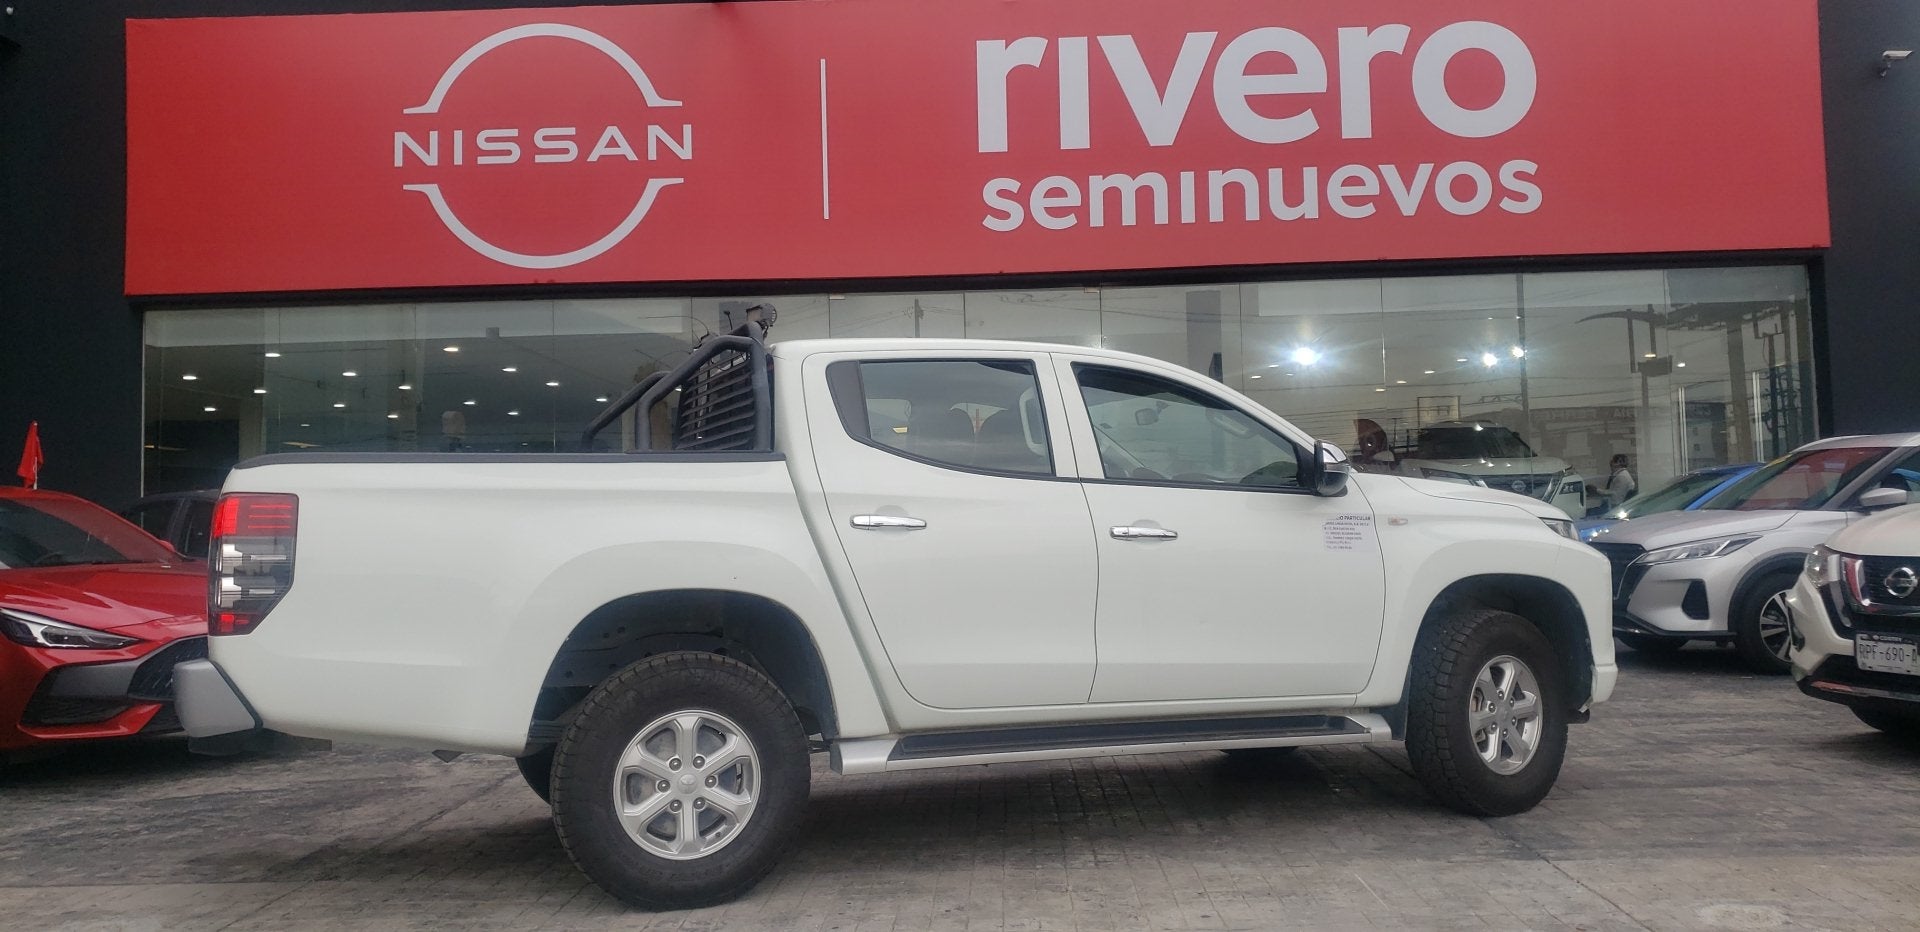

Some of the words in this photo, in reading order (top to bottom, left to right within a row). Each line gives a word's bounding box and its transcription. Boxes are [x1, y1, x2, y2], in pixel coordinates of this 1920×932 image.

[976, 20, 1537, 152] rivero
[395, 123, 692, 168] NISSAN
[983, 160, 1542, 231] seminuevos
